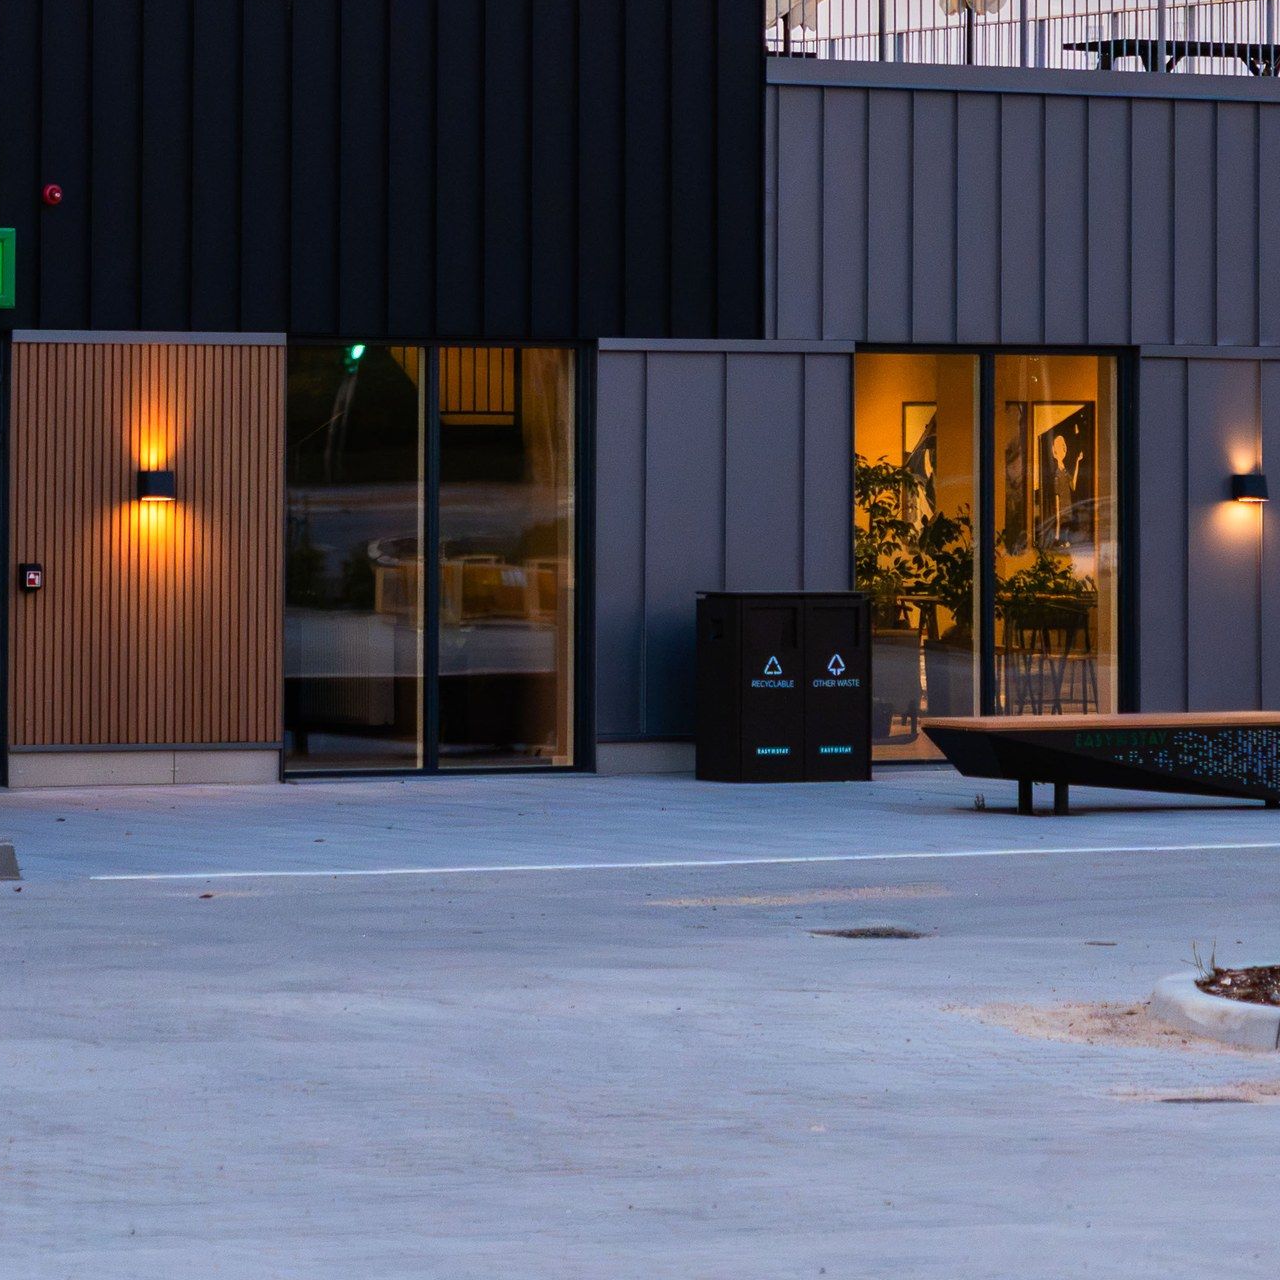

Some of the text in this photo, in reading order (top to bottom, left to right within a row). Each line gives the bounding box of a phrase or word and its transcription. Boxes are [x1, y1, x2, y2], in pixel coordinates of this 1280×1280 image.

[751, 679, 795, 688] RECYCLABLE
[812, 678, 861, 688] OTHER WASTE
